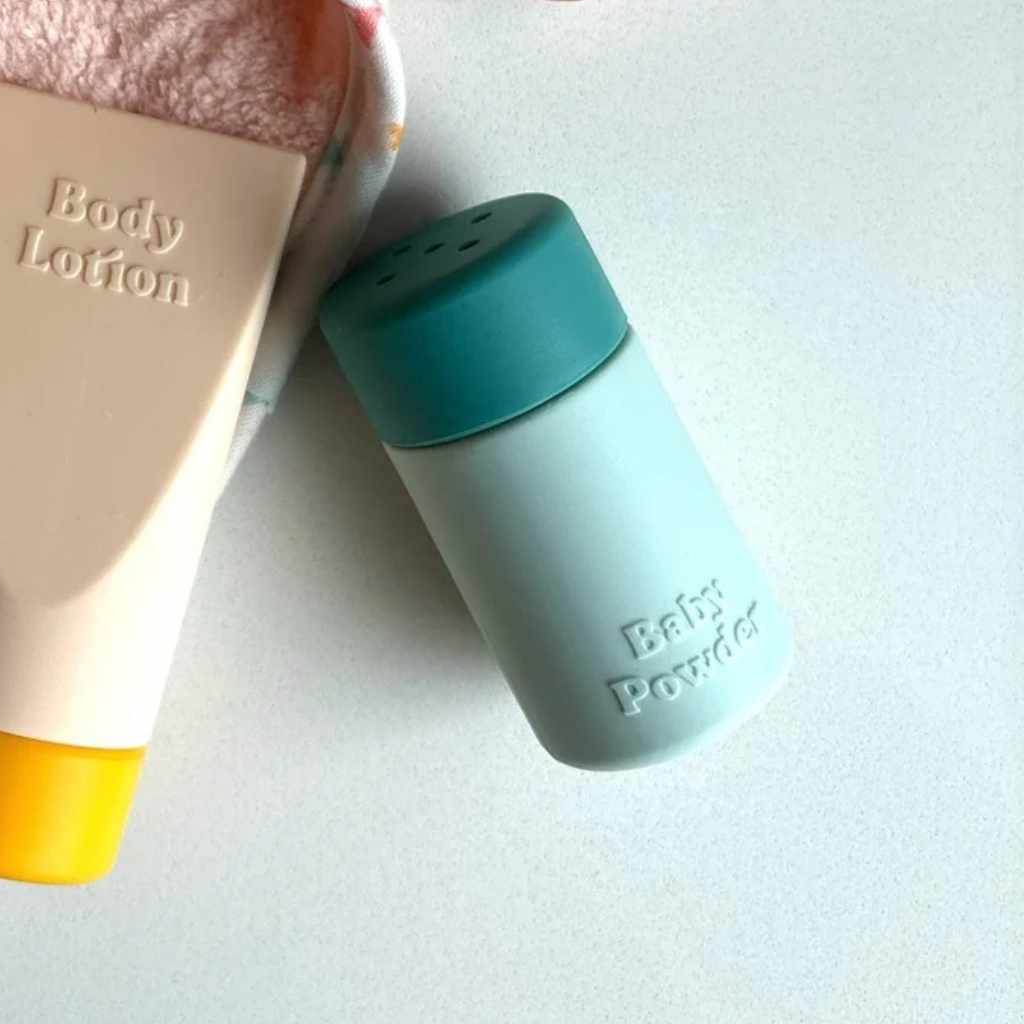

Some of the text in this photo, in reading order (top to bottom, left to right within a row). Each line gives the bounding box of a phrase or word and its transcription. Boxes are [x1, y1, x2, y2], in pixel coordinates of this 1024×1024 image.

[46, 176, 184, 255] Body
[17, 225, 189, 308] Lotion
[607, 600, 760, 716] Powder
[621, 578, 724, 660] Baby
